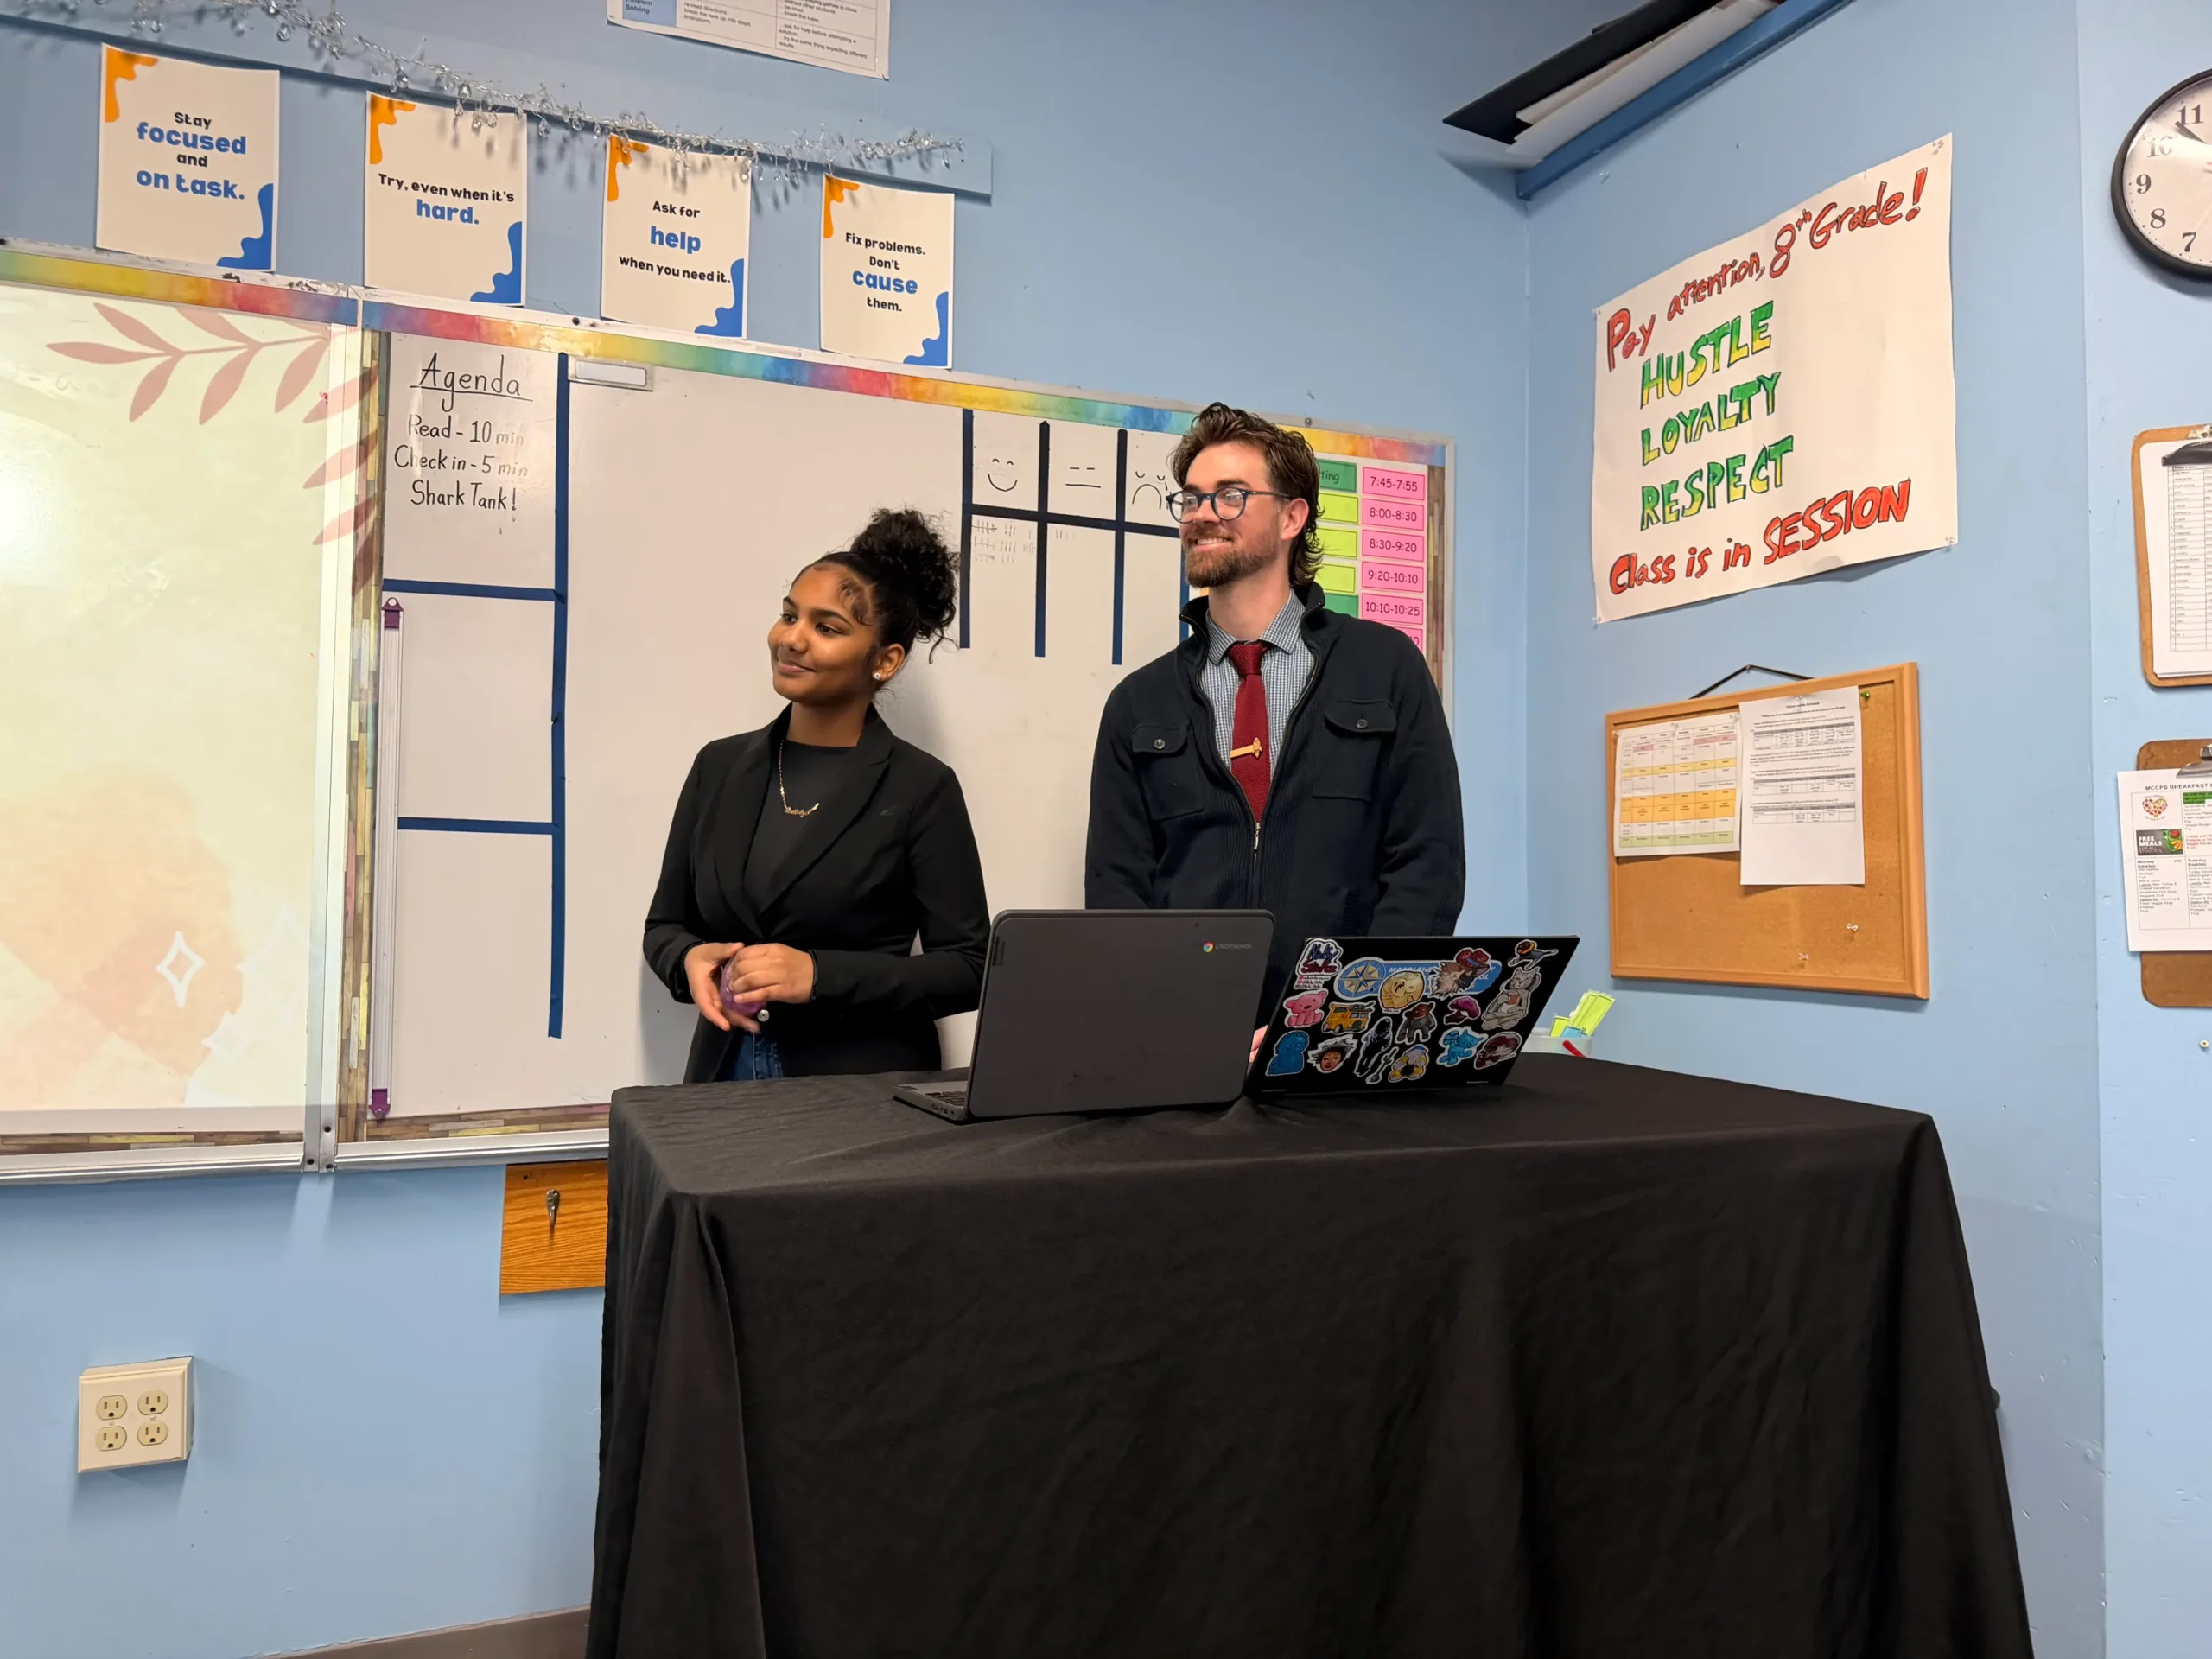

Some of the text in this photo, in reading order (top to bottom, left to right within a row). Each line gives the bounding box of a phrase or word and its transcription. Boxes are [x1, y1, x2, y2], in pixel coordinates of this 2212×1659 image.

[626, 3, 650, 15] Solving
[175, 111, 212, 130] Stay
[2177, 104, 2204, 125] 11
[137, 121, 246, 155] focused
[2146, 135, 2173, 157] 10
[176, 154, 208, 168] and
[136, 170, 245, 200] on task.
[378, 173, 514, 202] Try, even when it's
[2135, 174, 2152, 194] 9
[416, 198, 479, 225] hard.
[652, 200, 700, 218] Ask for
[2150, 208, 2166, 228] 8
[650, 225, 701, 254] help
[845, 232, 925, 255] Fix problems.
[2182, 232, 2197, 252] 7
[619, 256, 731, 283] when you need it.
[869, 255, 900, 270] Don't
[1607, 308, 1656, 373] Pay
[1769, 208, 1813, 279] 8th
[1809, 167, 1929, 250] Grade!
[852, 270, 918, 295] cause
[867, 296, 902, 312] them.
[1640, 300, 1774, 410] HUSTLE
[418, 352, 521, 412] Agenda
[408, 413, 451, 438] Read
[469, 420, 493, 443] 10
[495, 431, 524, 447] min
[1641, 371, 1782, 467] LOYALTY
[394, 444, 448, 470] Check
[451, 456, 466, 471] in
[481, 454, 496, 474] 5
[498, 461, 528, 478] min
[1370, 476, 1418, 492] 7:45-7:55
[1640, 435, 1794, 531] RESPECT
[410, 479, 518, 512] Shark Tank!
[1370, 507, 1417, 522] 8:00-8:30
[1370, 538, 1417, 553] 8:30-9:20
[1609, 477, 1911, 595] Class is in SESSION
[1368, 570, 1419, 584] 9:20-10:10
[1365, 601, 1420, 617] 10:10-10:25
